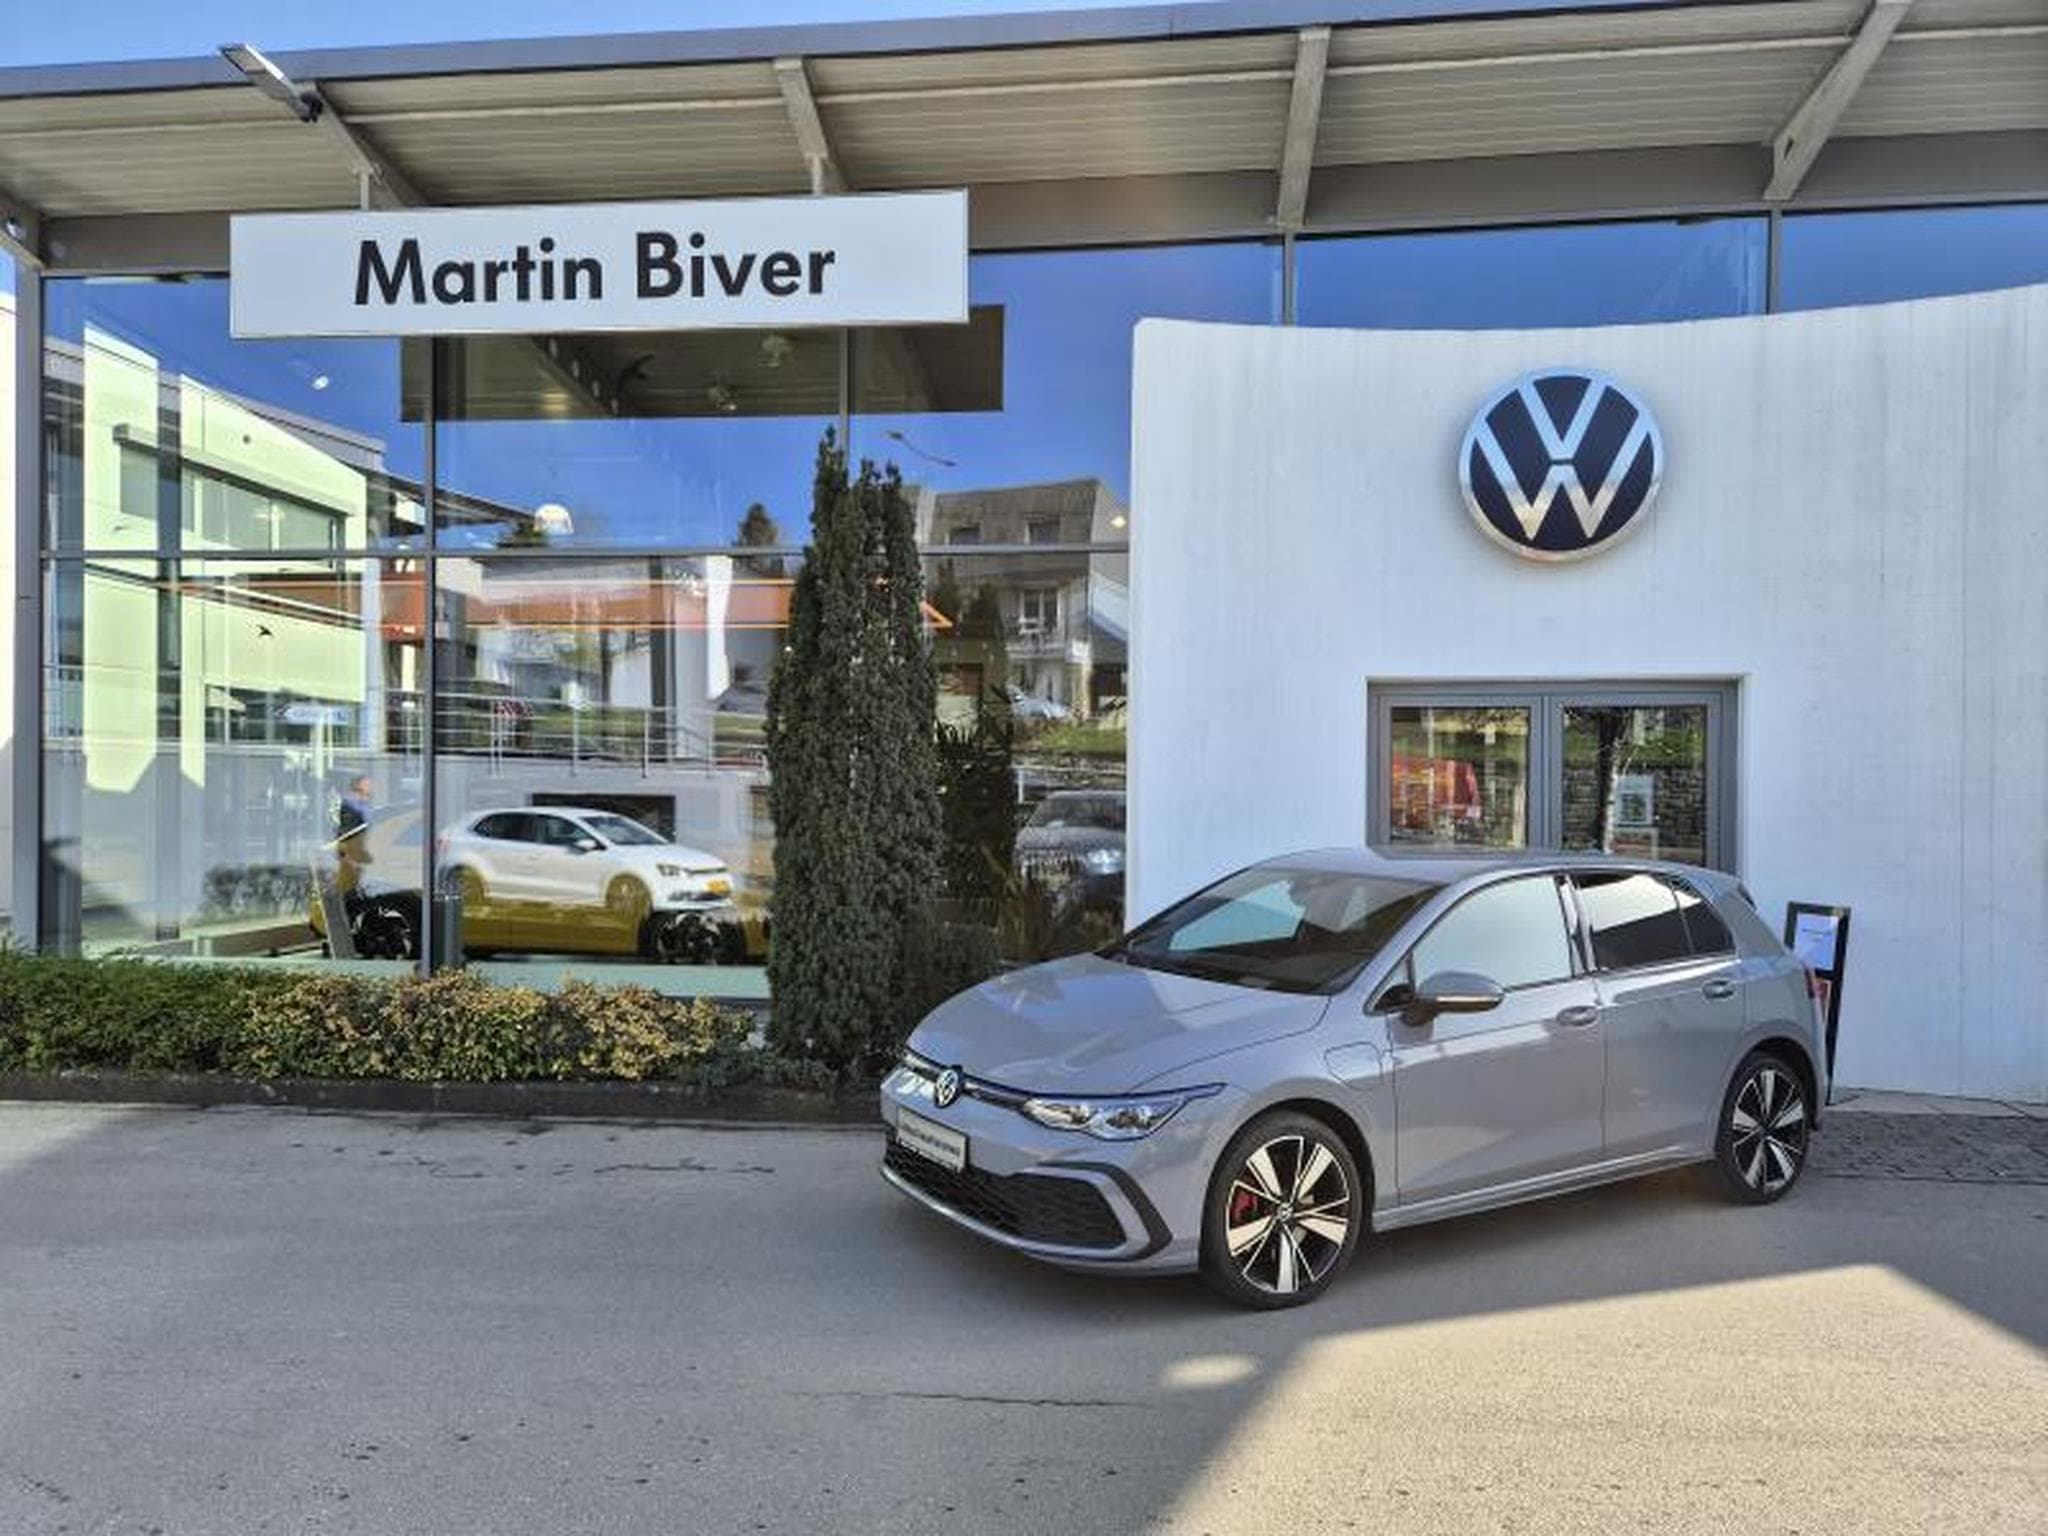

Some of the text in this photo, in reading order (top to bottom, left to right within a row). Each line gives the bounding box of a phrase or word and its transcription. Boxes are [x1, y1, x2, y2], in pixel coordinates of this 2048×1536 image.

[355, 231, 835, 306] Martin Biver
[1466, 370, 1656, 549] VW
